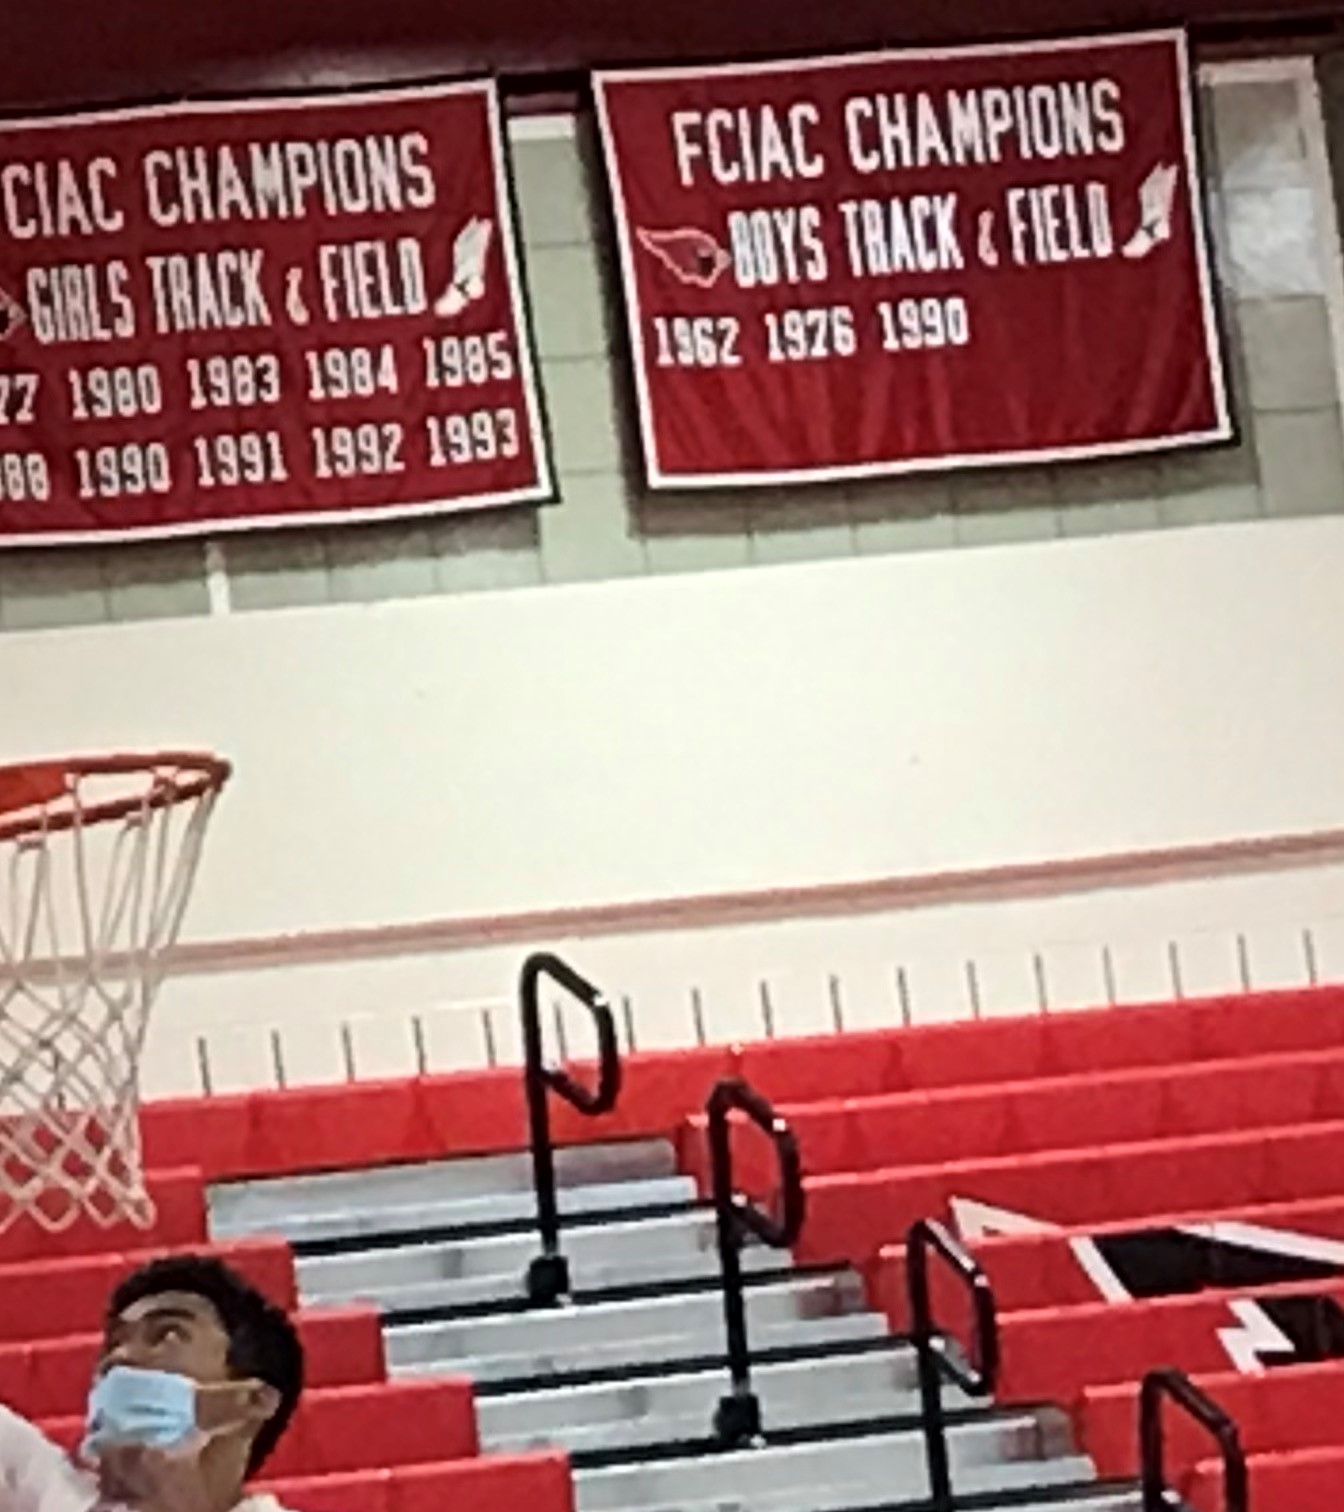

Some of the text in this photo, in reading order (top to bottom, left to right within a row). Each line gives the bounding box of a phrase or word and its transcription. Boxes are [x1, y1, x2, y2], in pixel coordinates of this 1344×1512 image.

[143, 132, 435, 227] CHAMPIONS
[671, 78, 1125, 186] FCIAC CHAMPIONS
[728, 204, 828, 288] BOYS
[838, 192, 964, 278] TRACK
[1006, 181, 1114, 265] FIELD
[26, 260, 136, 344] GIRLS
[146, 249, 271, 334] TRACK
[320, 238, 427, 322] FIELD
[654, 297, 969, 367] 1962 1976 1990
[68, 365, 162, 420] 1980
[187, 356, 280, 410] 1983
[306, 343, 398, 401] 1984
[423, 330, 513, 388] 1985
[75, 442, 172, 498] 1990
[194, 430, 288, 487] 1991
[312, 422, 405, 479] 1992
[426, 407, 519, 467] 1993
